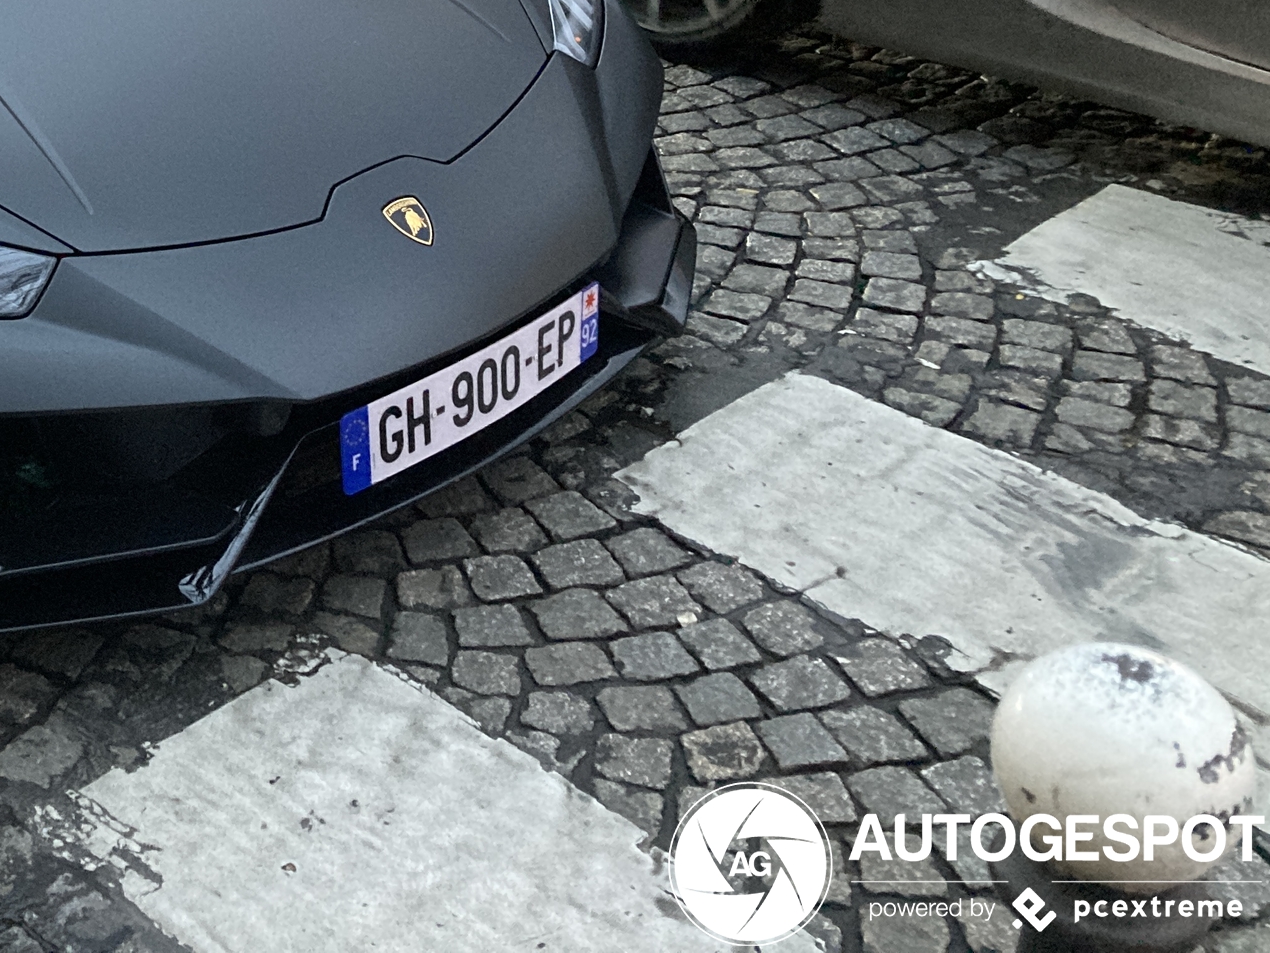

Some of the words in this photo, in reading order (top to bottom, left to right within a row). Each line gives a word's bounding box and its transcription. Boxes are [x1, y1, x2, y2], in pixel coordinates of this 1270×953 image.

[581, 321, 598, 348] 92
[379, 310, 576, 464] GH-900-EP
[351, 452, 362, 472] F
